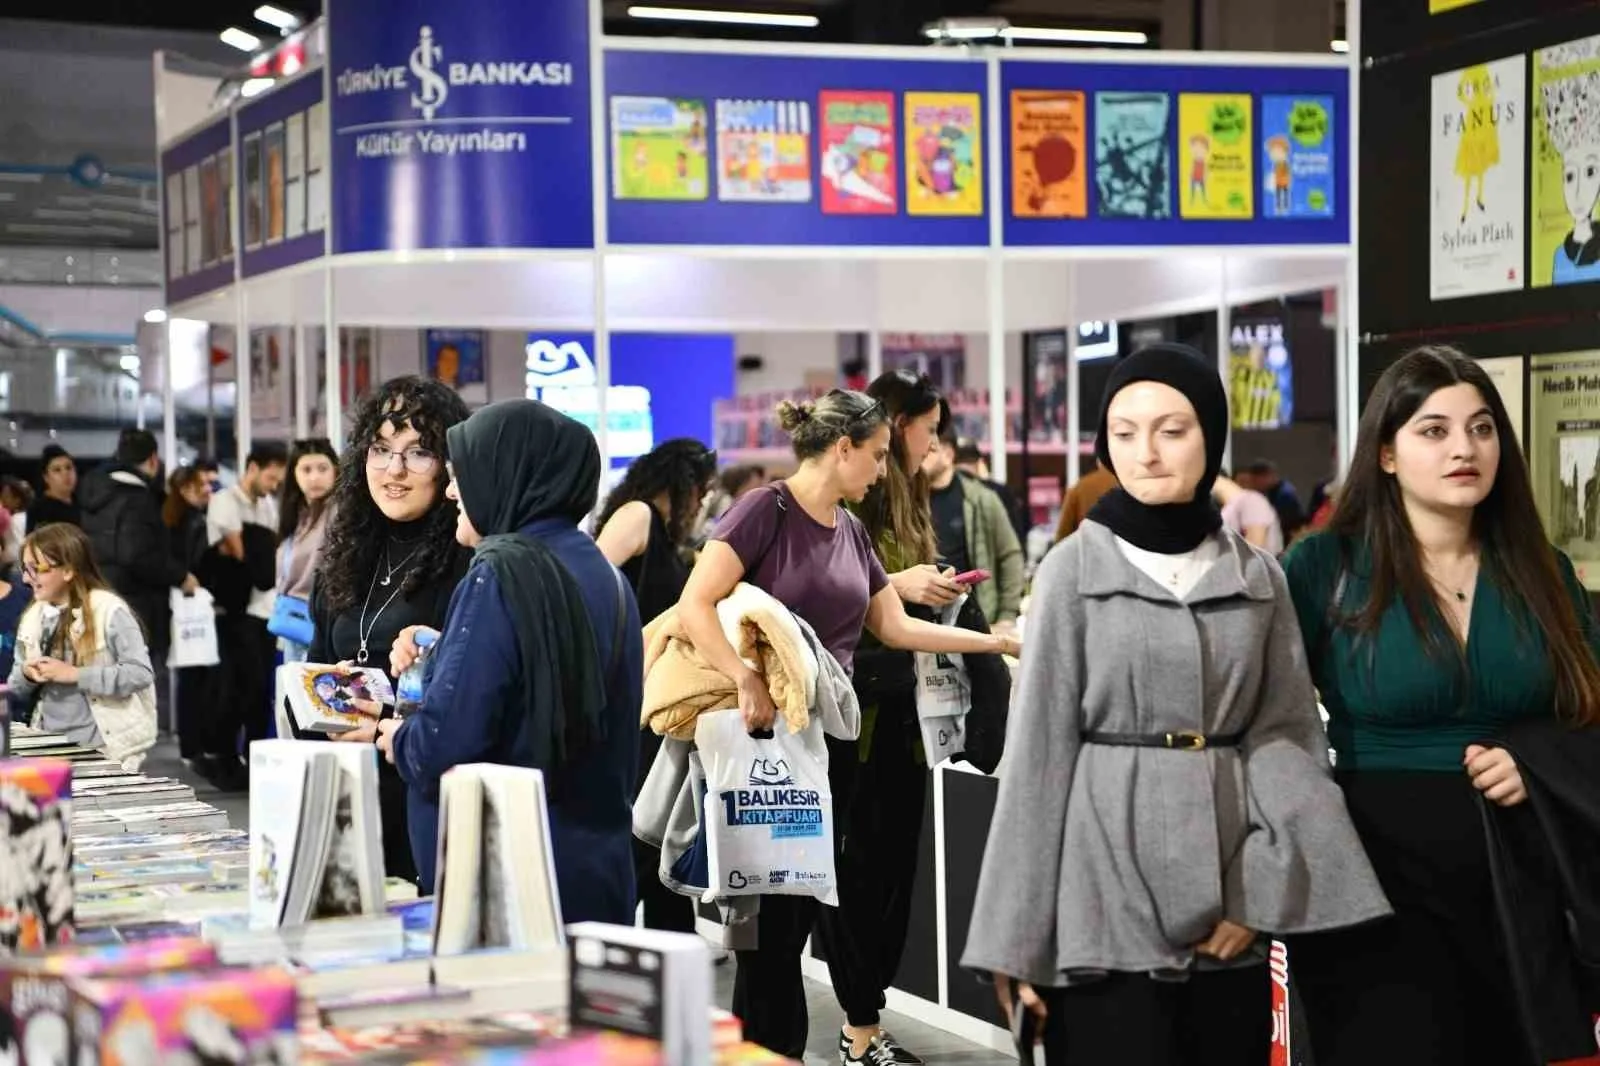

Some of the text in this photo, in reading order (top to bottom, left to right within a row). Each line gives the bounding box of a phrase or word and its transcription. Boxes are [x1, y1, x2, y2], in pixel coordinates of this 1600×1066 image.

[337, 64, 407, 96] TÜRKİYE
[449, 63, 571, 86] BANKASI
[1442, 101, 1515, 136] FANUS
[356, 130, 526, 156] Kültür Yayınları
[1441, 229, 1477, 254] Sylvia
[1482, 222, 1514, 243] Plath
[1230, 324, 1284, 344] ALEX
[738, 789, 820, 806] BALIKESİR
[785, 809, 820, 822] FUARI
